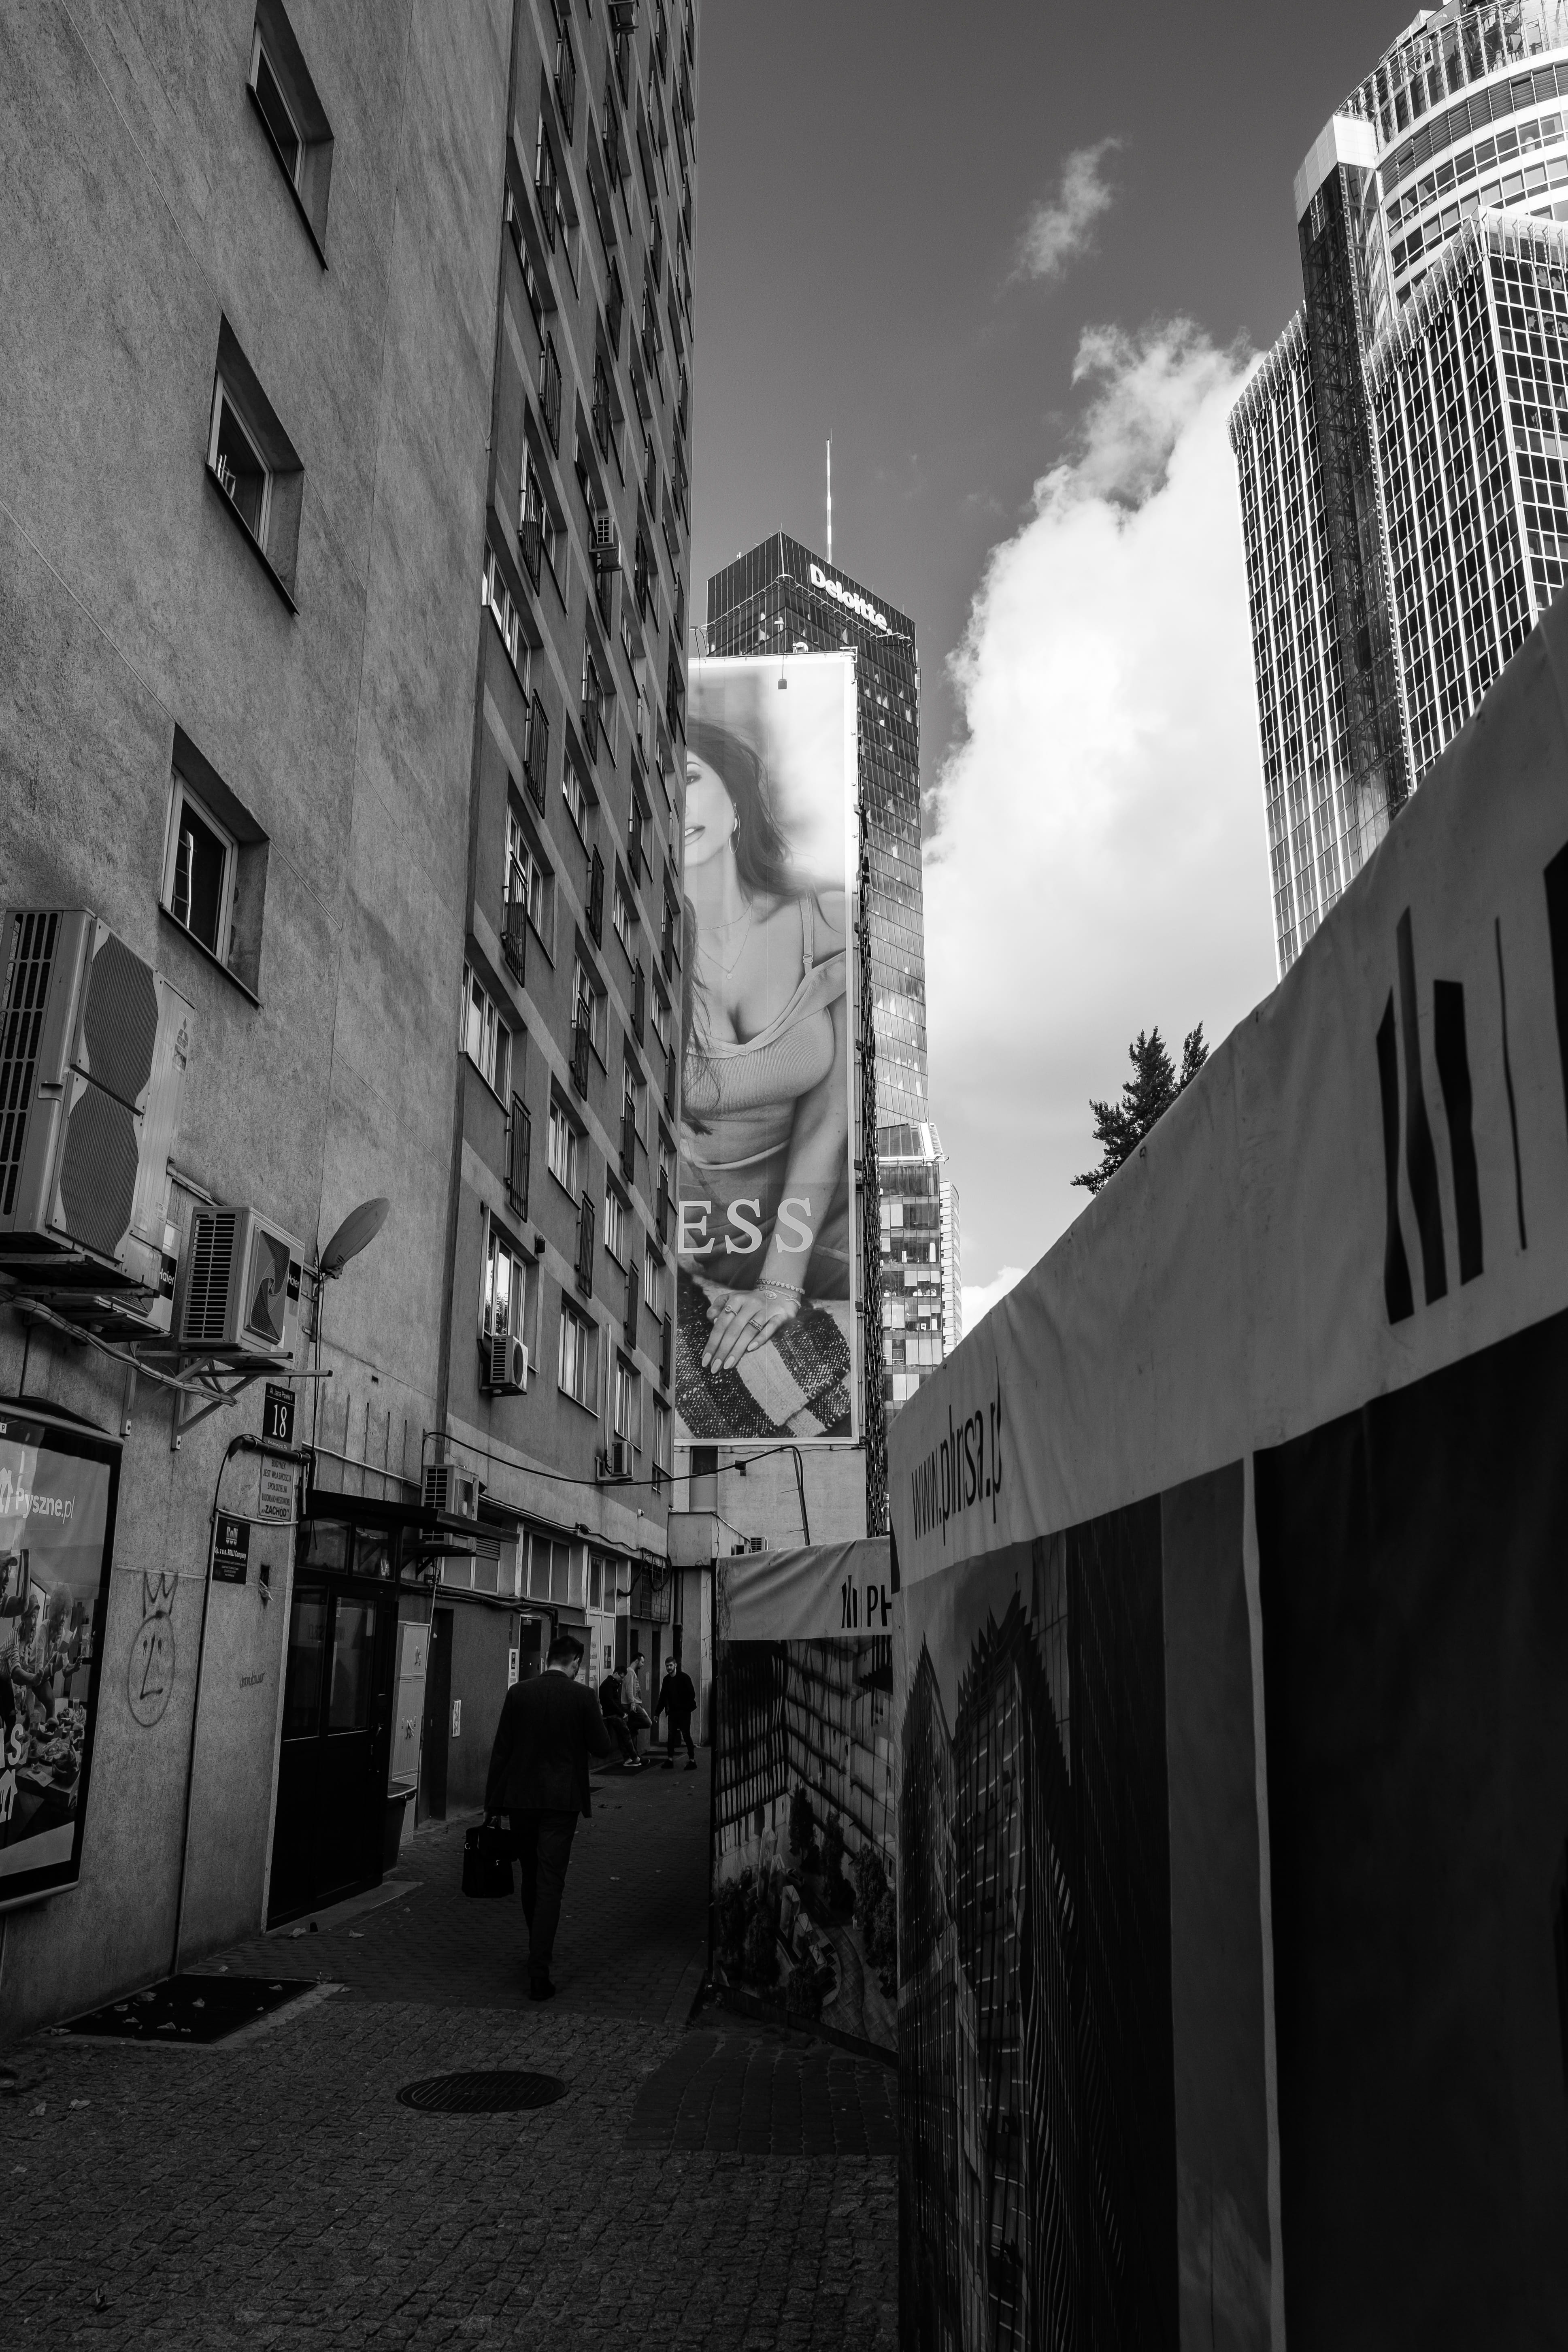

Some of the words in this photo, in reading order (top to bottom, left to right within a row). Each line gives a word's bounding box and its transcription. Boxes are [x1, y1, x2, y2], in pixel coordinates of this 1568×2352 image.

[272, 1404, 287, 1438] 18
[272, 1459, 286, 1470] BUDYNEK
[15, 1487, 75, 1524] Pyszne.pl
